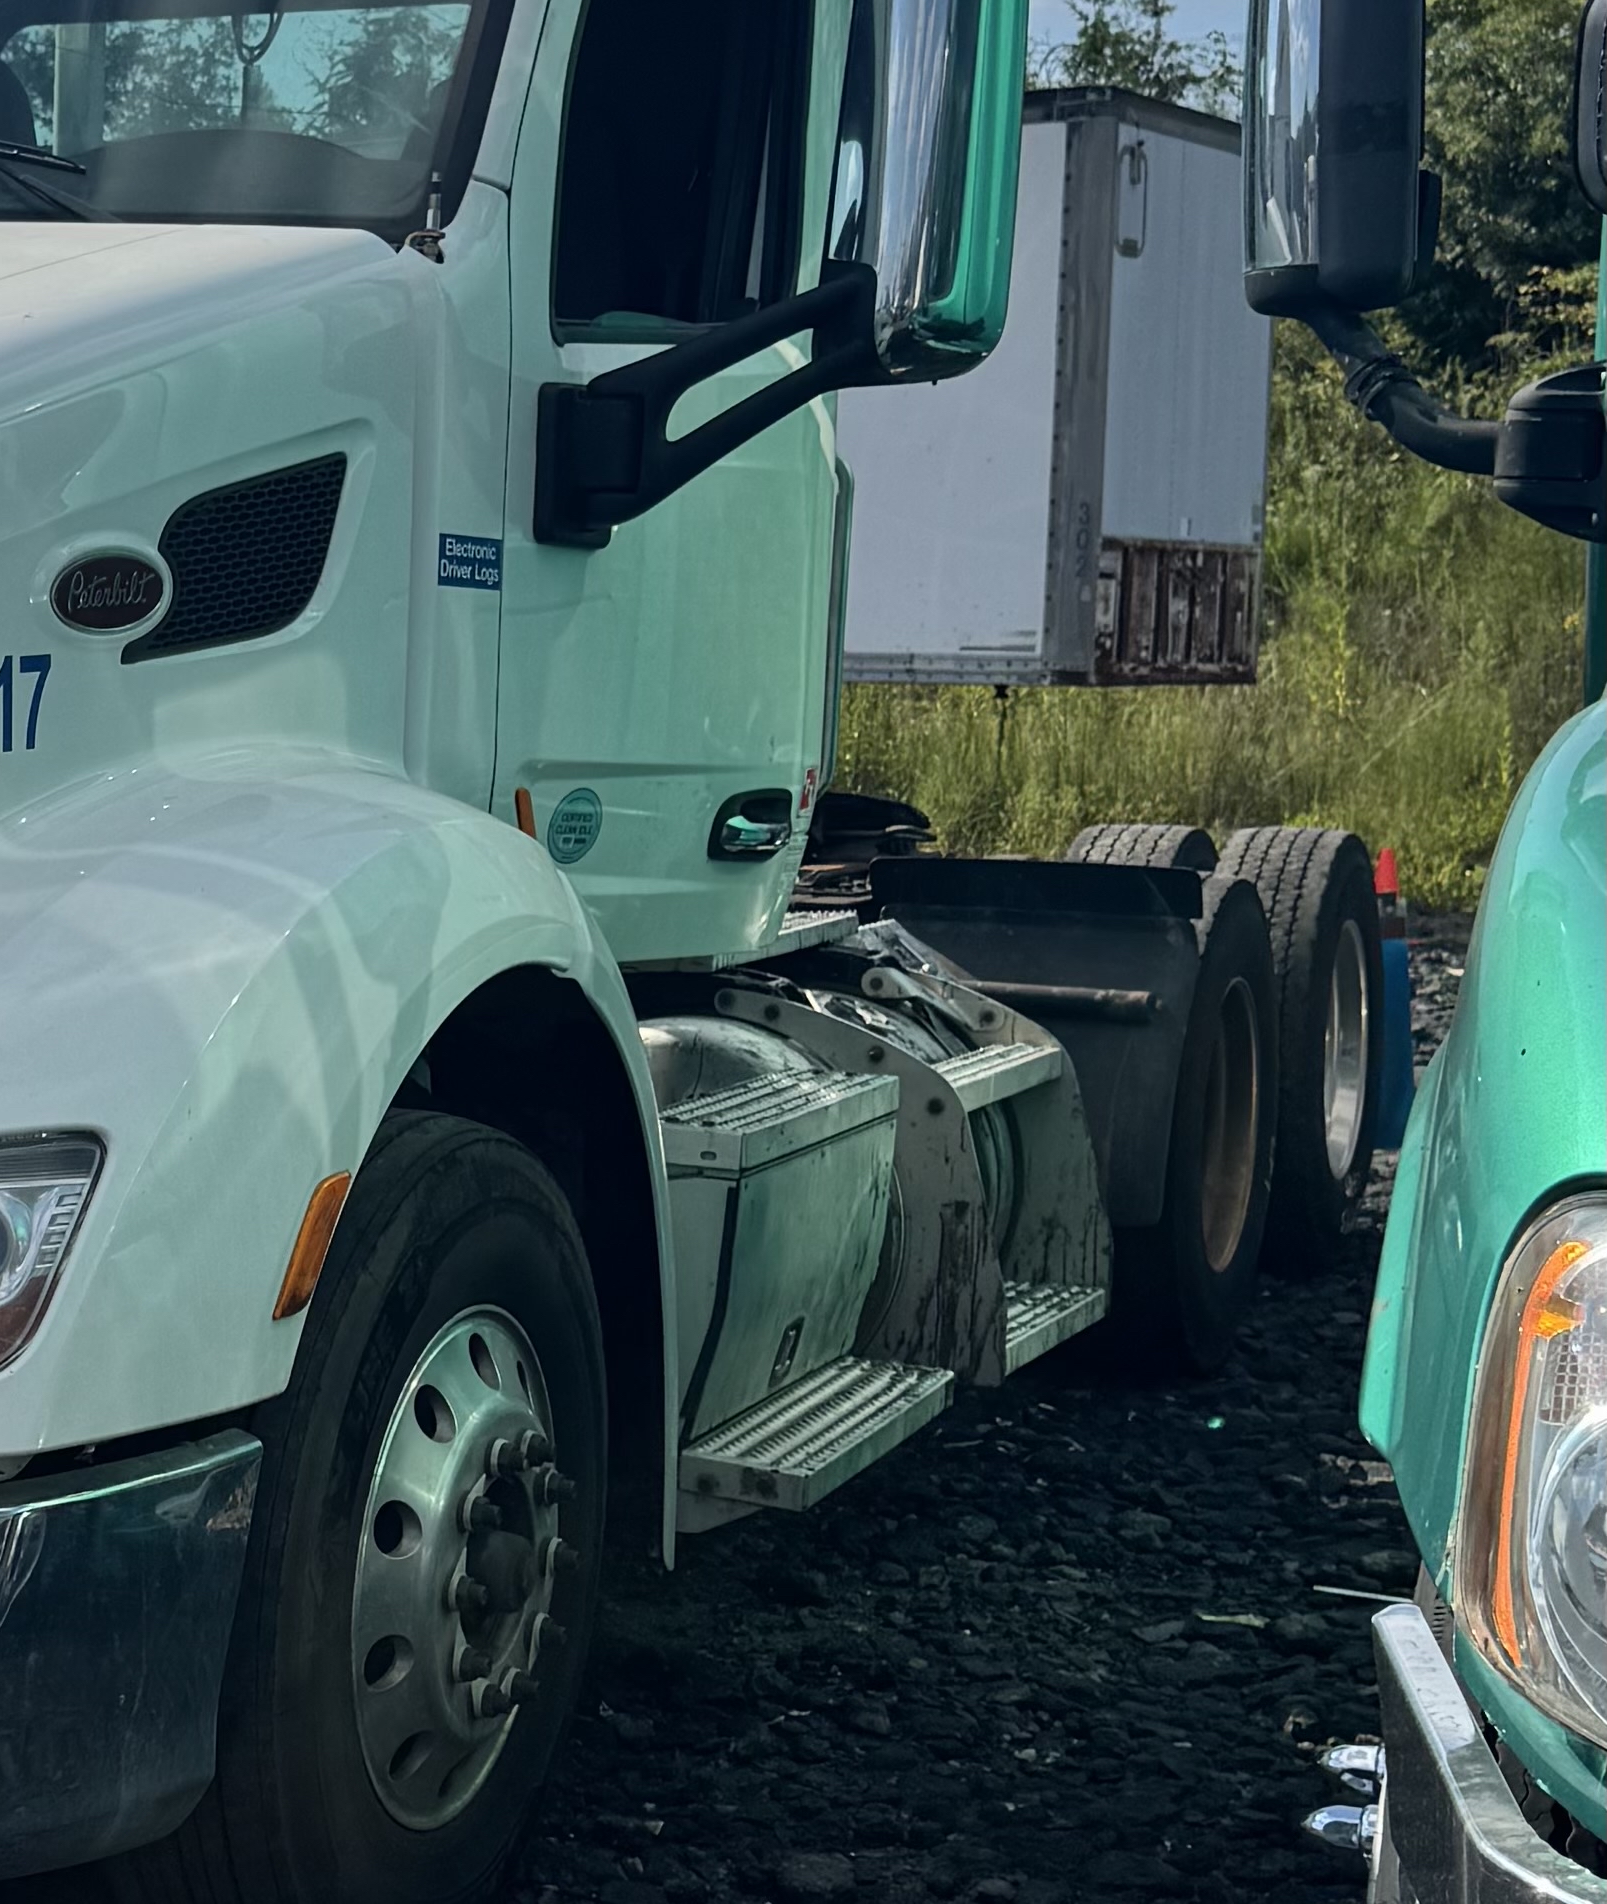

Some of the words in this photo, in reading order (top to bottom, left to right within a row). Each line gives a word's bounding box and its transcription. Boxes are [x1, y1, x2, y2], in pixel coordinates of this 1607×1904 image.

[445, 537, 497, 561] Electronic
[440, 558, 473, 580] Driver
[474, 562, 500, 586] Logs
[67, 570, 156, 614] Peterbilt
